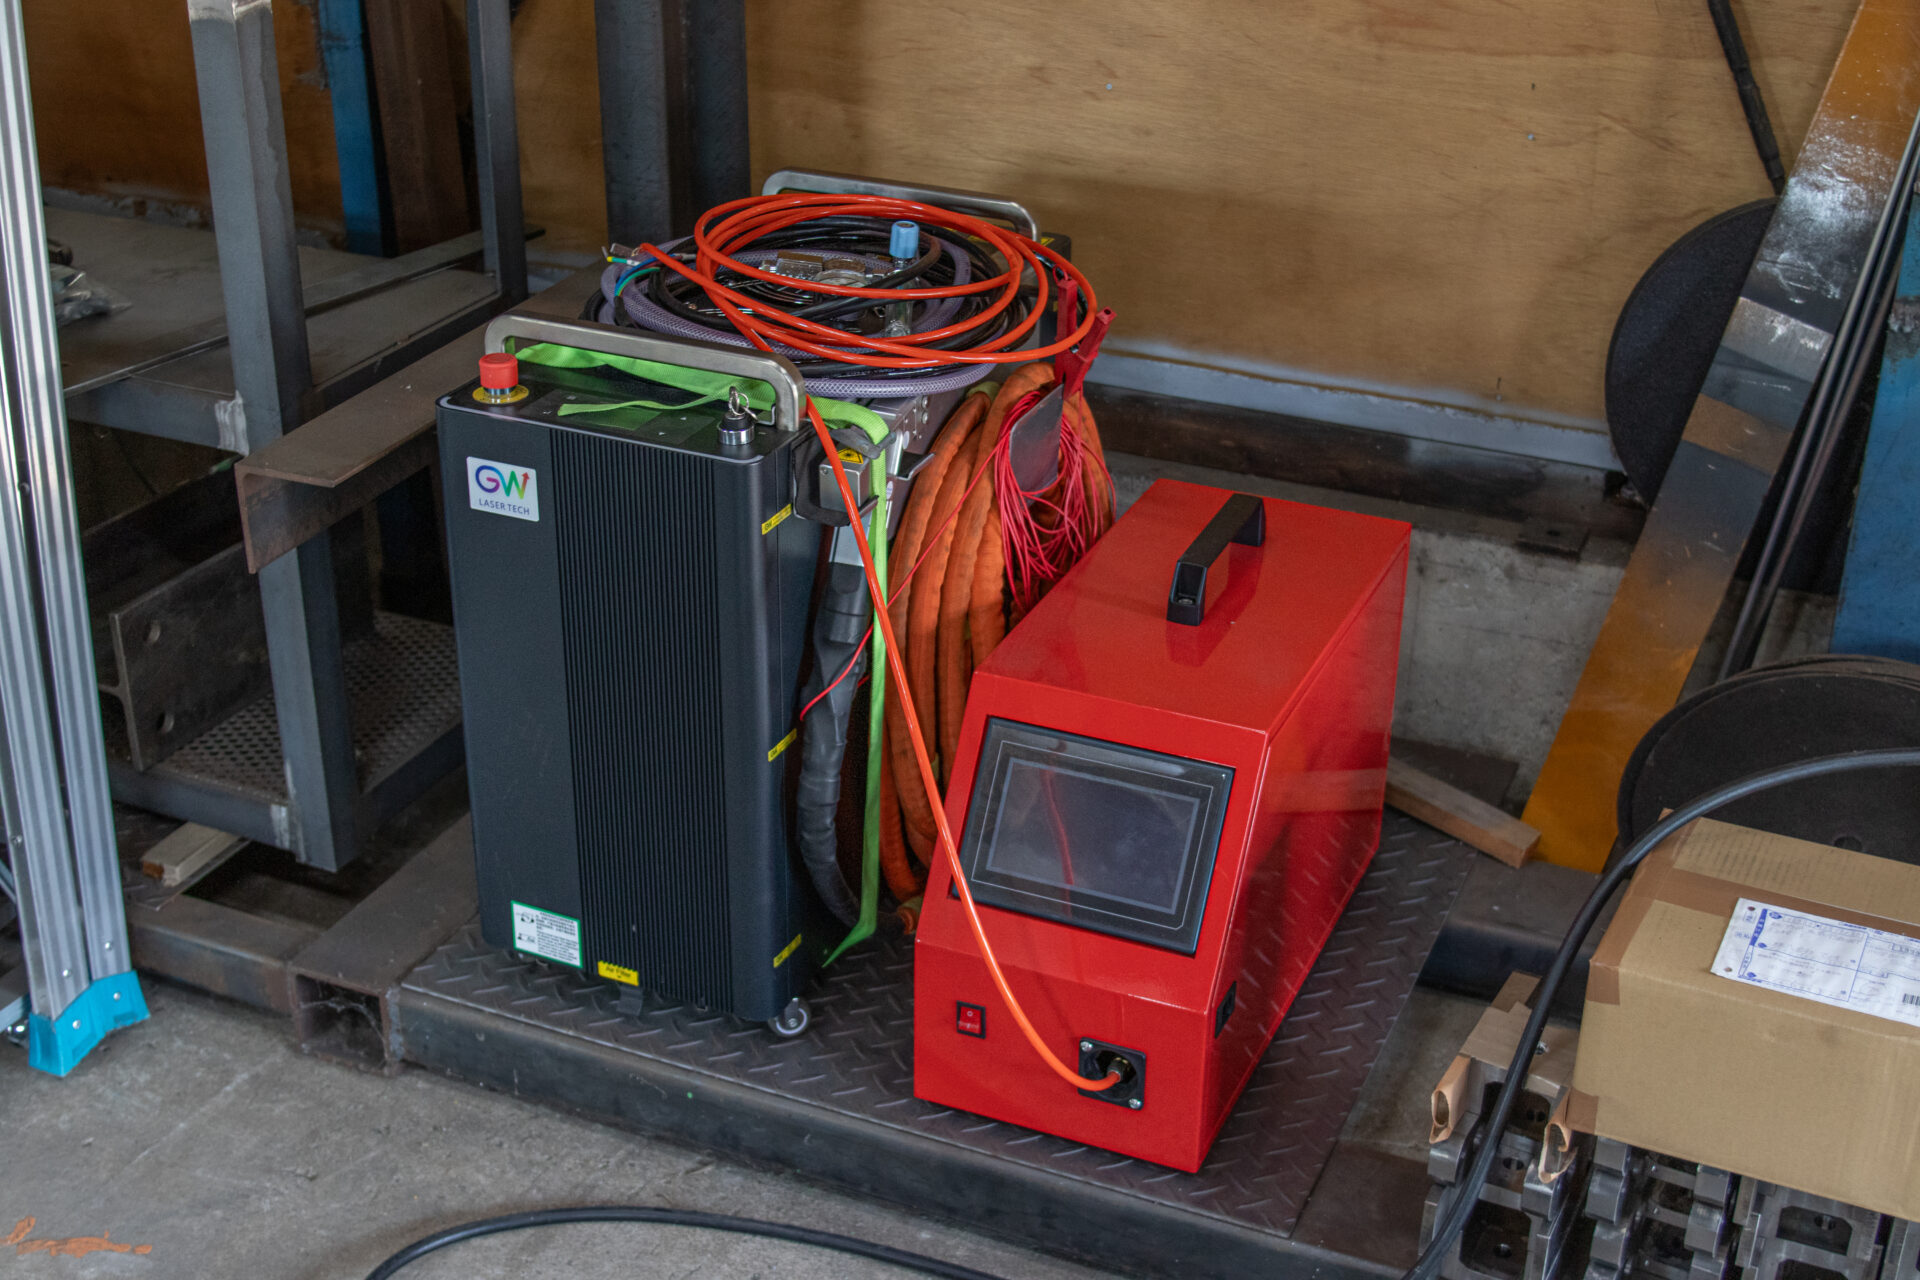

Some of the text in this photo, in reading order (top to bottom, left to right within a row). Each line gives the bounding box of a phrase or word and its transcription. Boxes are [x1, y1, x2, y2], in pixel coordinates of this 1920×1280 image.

[475, 465, 530, 500] GW
[479, 498, 530, 515] LASER TECH
